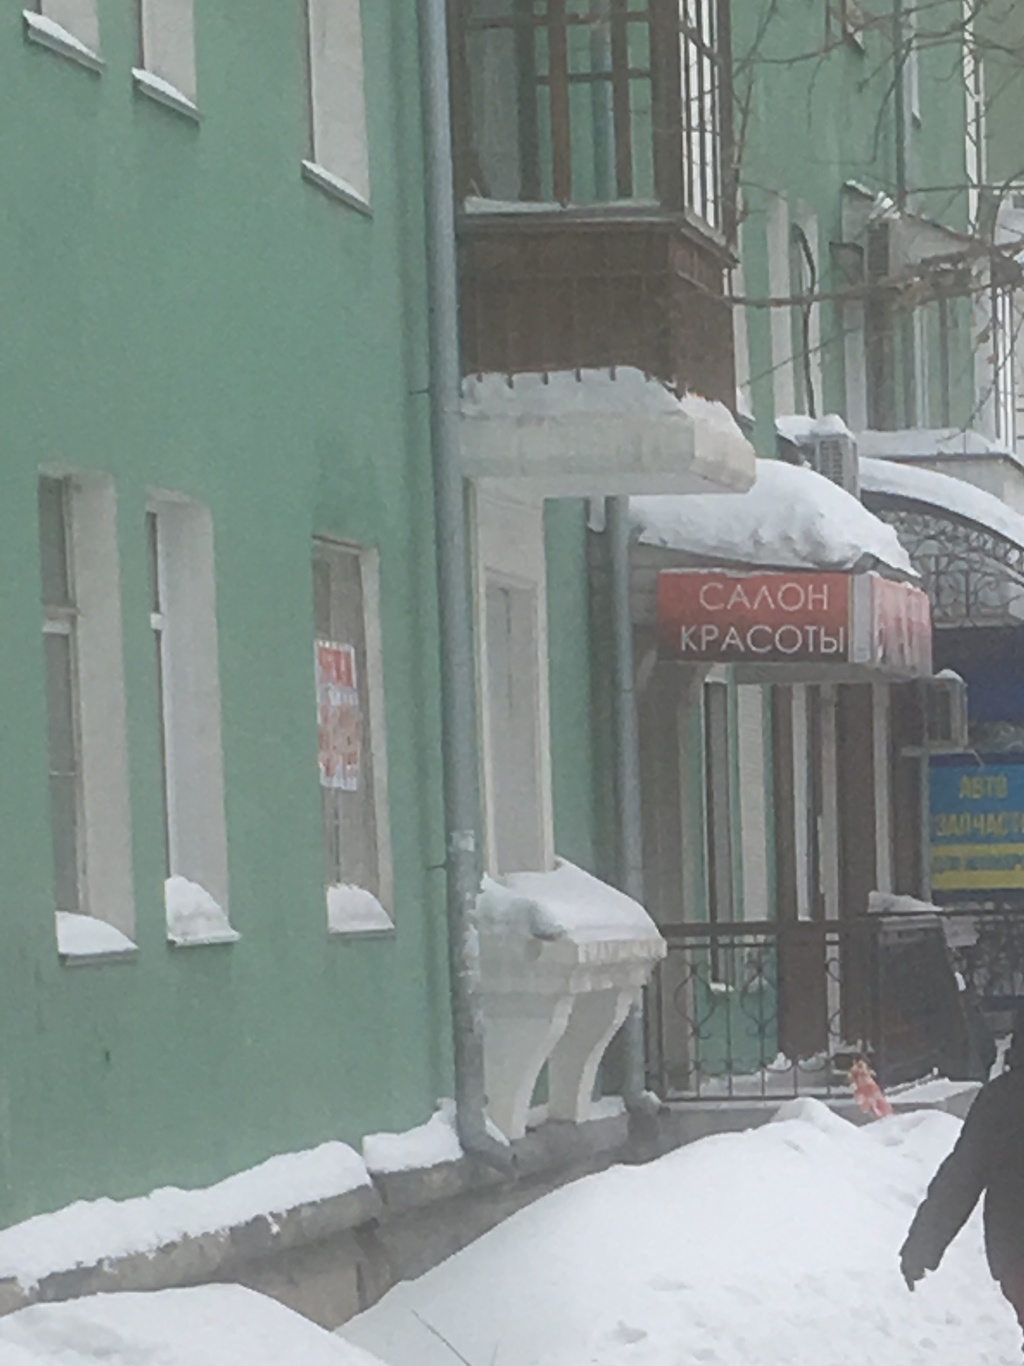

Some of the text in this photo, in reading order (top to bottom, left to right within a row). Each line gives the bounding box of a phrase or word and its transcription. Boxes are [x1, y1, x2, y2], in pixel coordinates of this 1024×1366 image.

[699, 581, 829, 611] САЛОН
[680, 623, 846, 653] КРАСОТЫ
[958, 774, 1008, 799] АВТО
